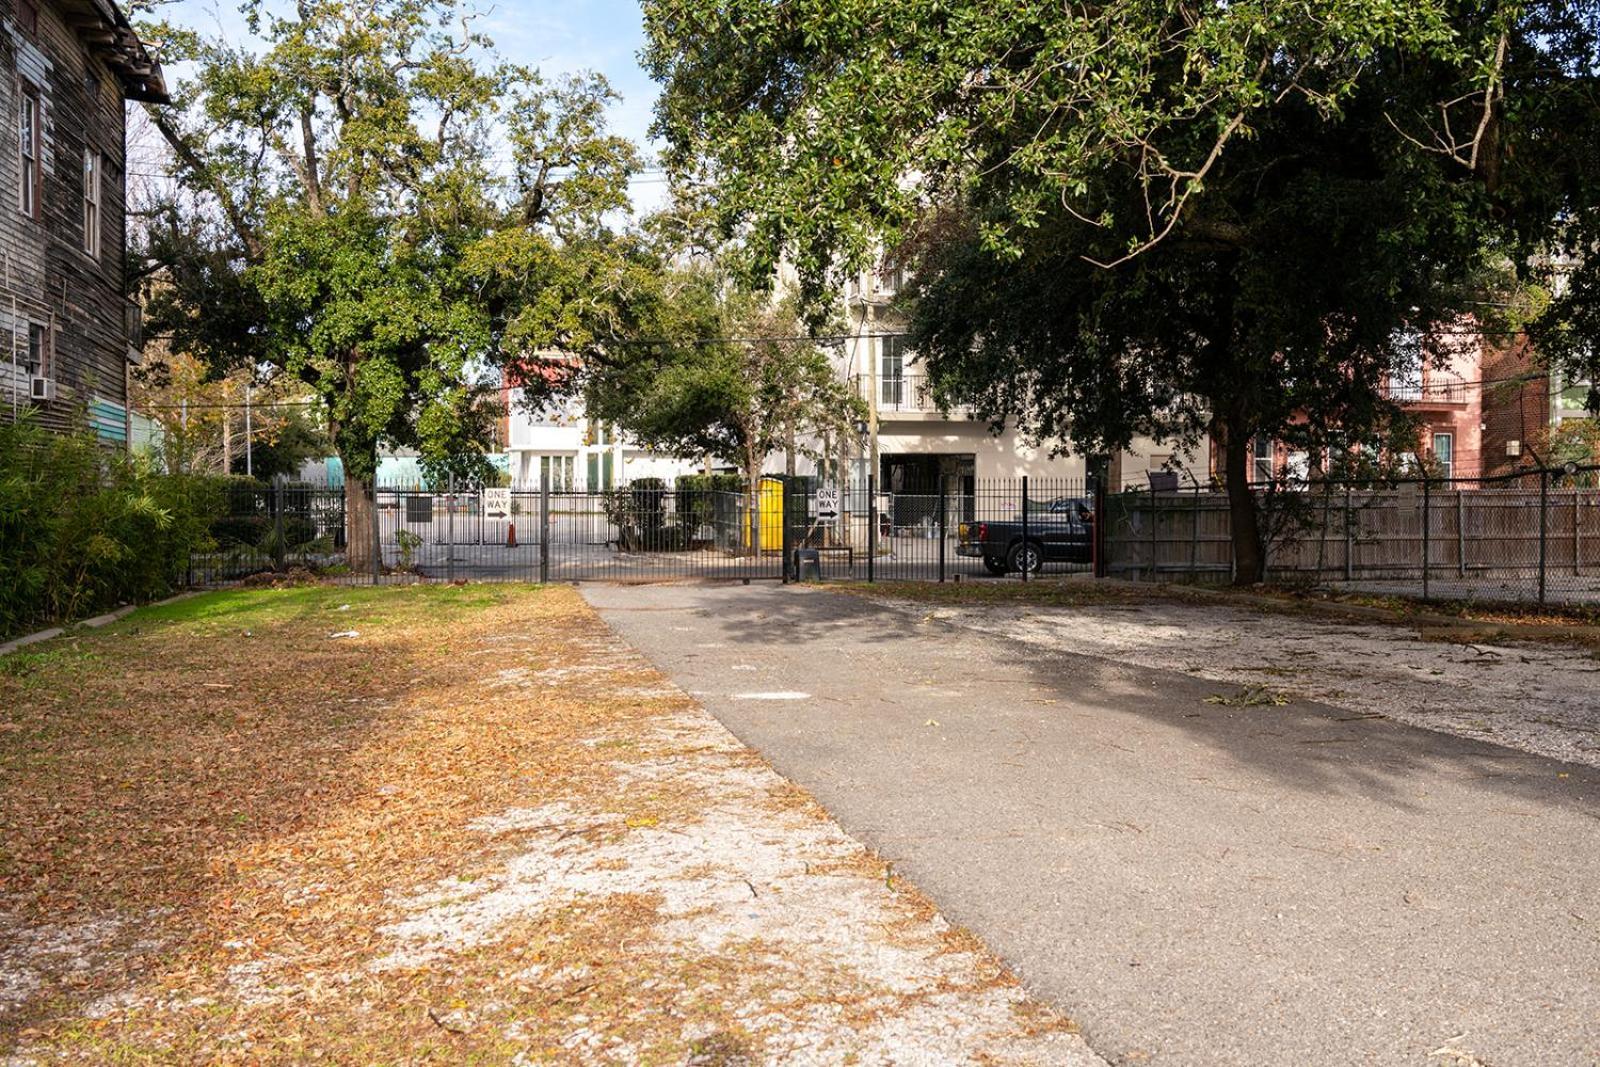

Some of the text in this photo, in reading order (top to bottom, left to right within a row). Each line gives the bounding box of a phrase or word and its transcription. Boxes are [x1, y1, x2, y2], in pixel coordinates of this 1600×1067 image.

[487, 490, 507, 498] ONE
[819, 490, 837, 498] ONE
[487, 500, 508, 508] WAY
[819, 500, 838, 508] WAY
